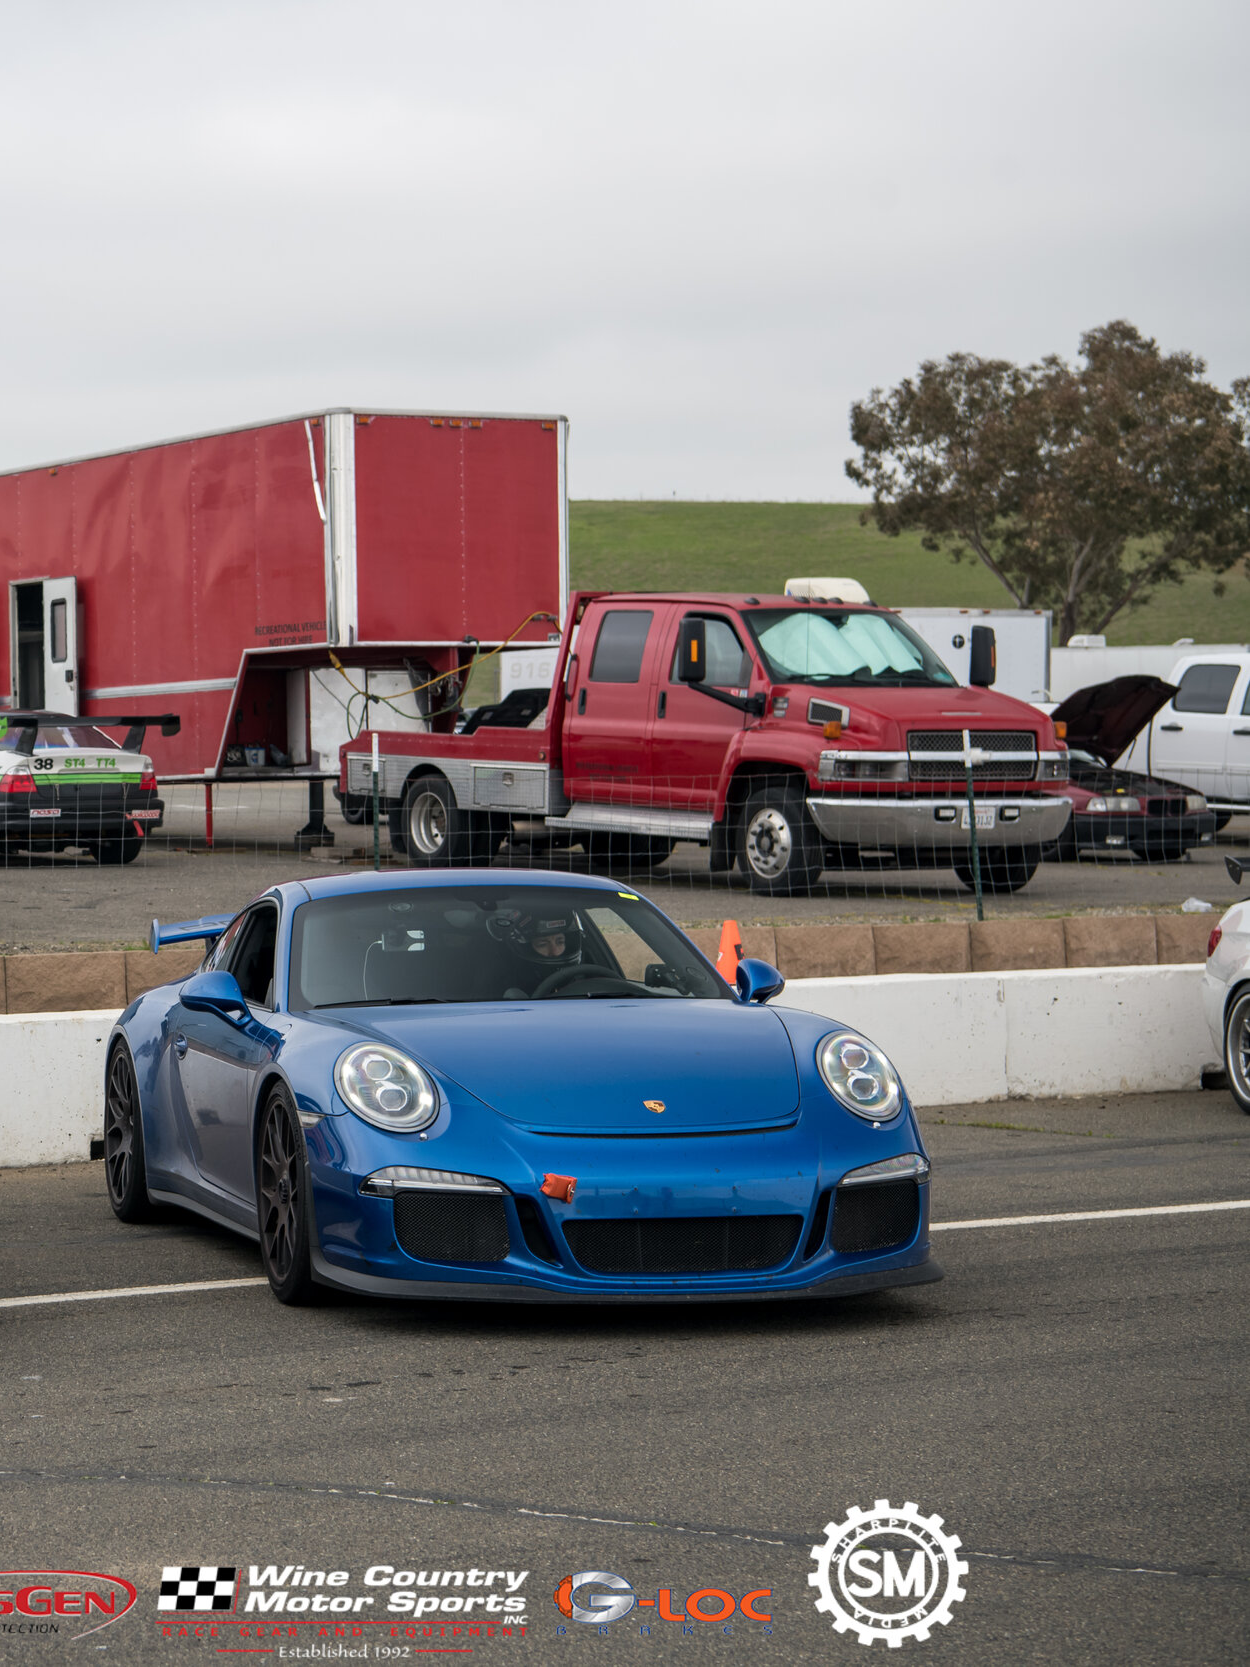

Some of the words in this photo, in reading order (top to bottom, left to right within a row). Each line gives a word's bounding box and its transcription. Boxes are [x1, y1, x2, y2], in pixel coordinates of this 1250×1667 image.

[511, 662, 551, 679] 916
[34, 758, 53, 770] 38
[64, 758, 86, 768] ST4
[96, 758, 116, 768] TT4
